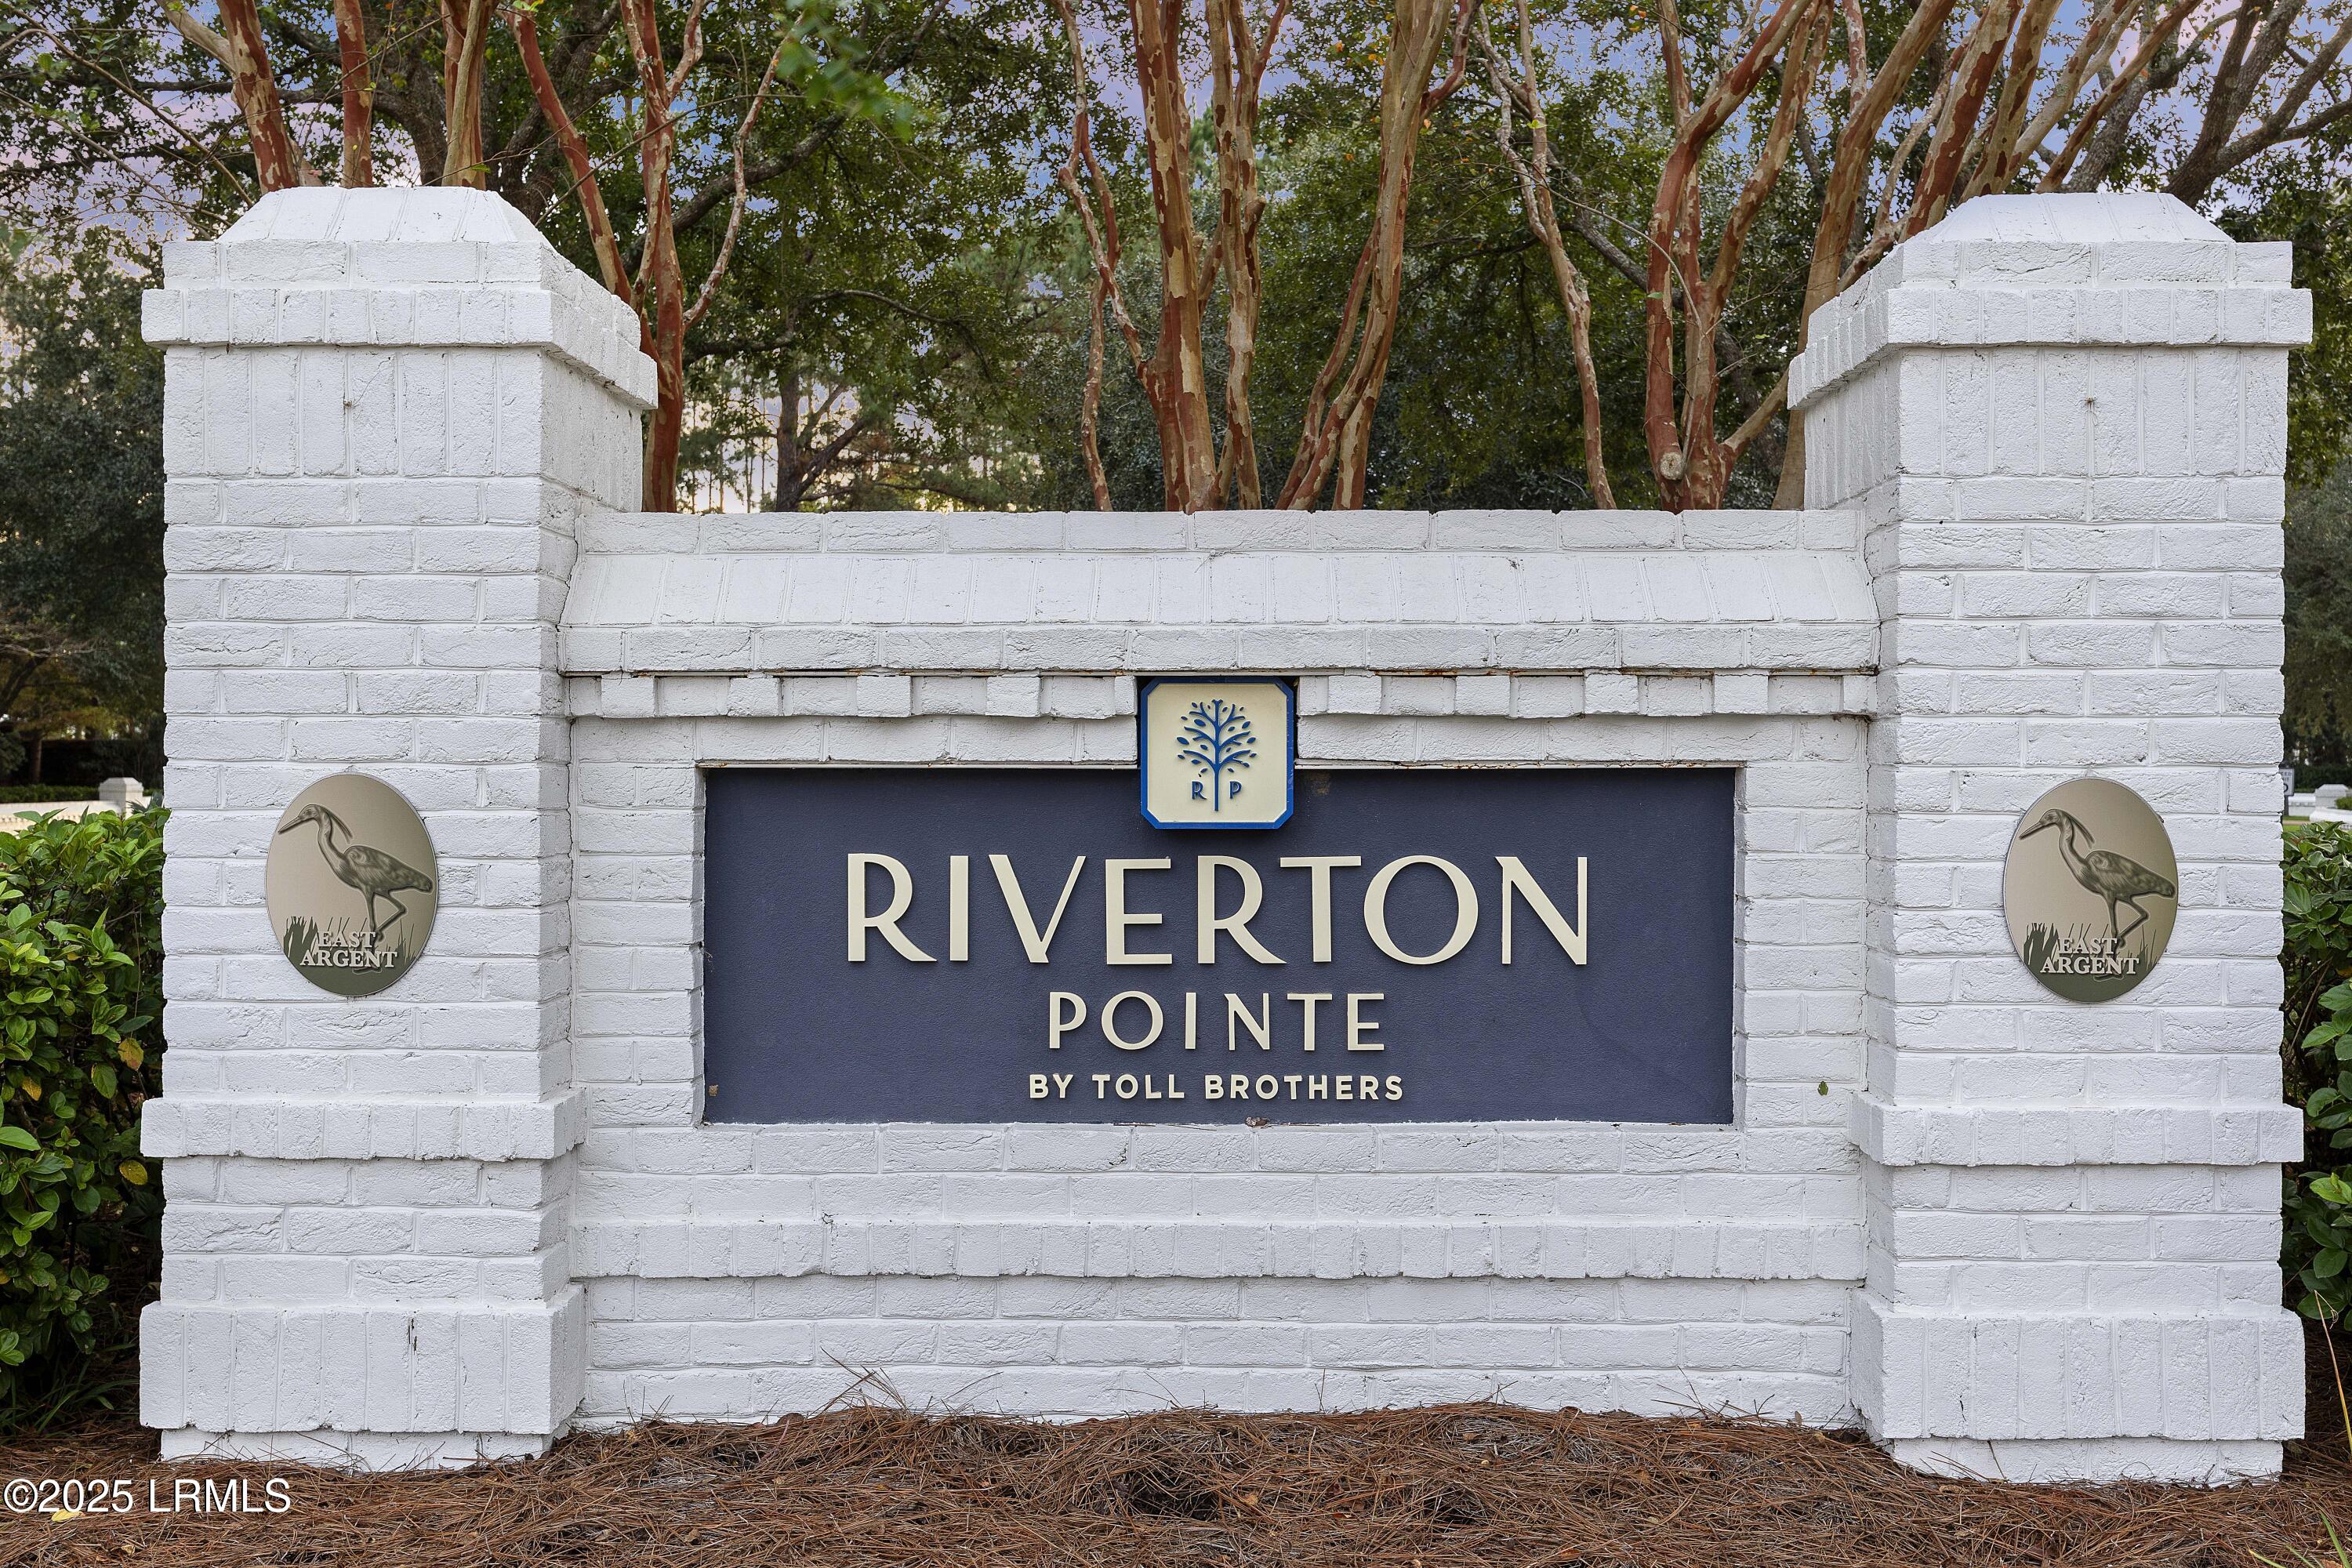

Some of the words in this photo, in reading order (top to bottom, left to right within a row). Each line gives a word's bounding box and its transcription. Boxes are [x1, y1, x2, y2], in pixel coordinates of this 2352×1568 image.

[1191, 780, 1207, 800] R
[1229, 780, 1242, 800] P
[847, 852, 1588, 966] RIVERTON
[318, 931, 376, 949] EAST
[2058, 937, 2118, 955] EAST
[299, 949, 397, 968] ARGENT
[2040, 956, 2140, 975] ARGENT
[1049, 990, 1385, 1051] POINTE
[1029, 1073, 1074, 1099] BY
[1091, 1073, 1185, 1100] TOLL
[1203, 1074, 1403, 1102] BROTHERS
